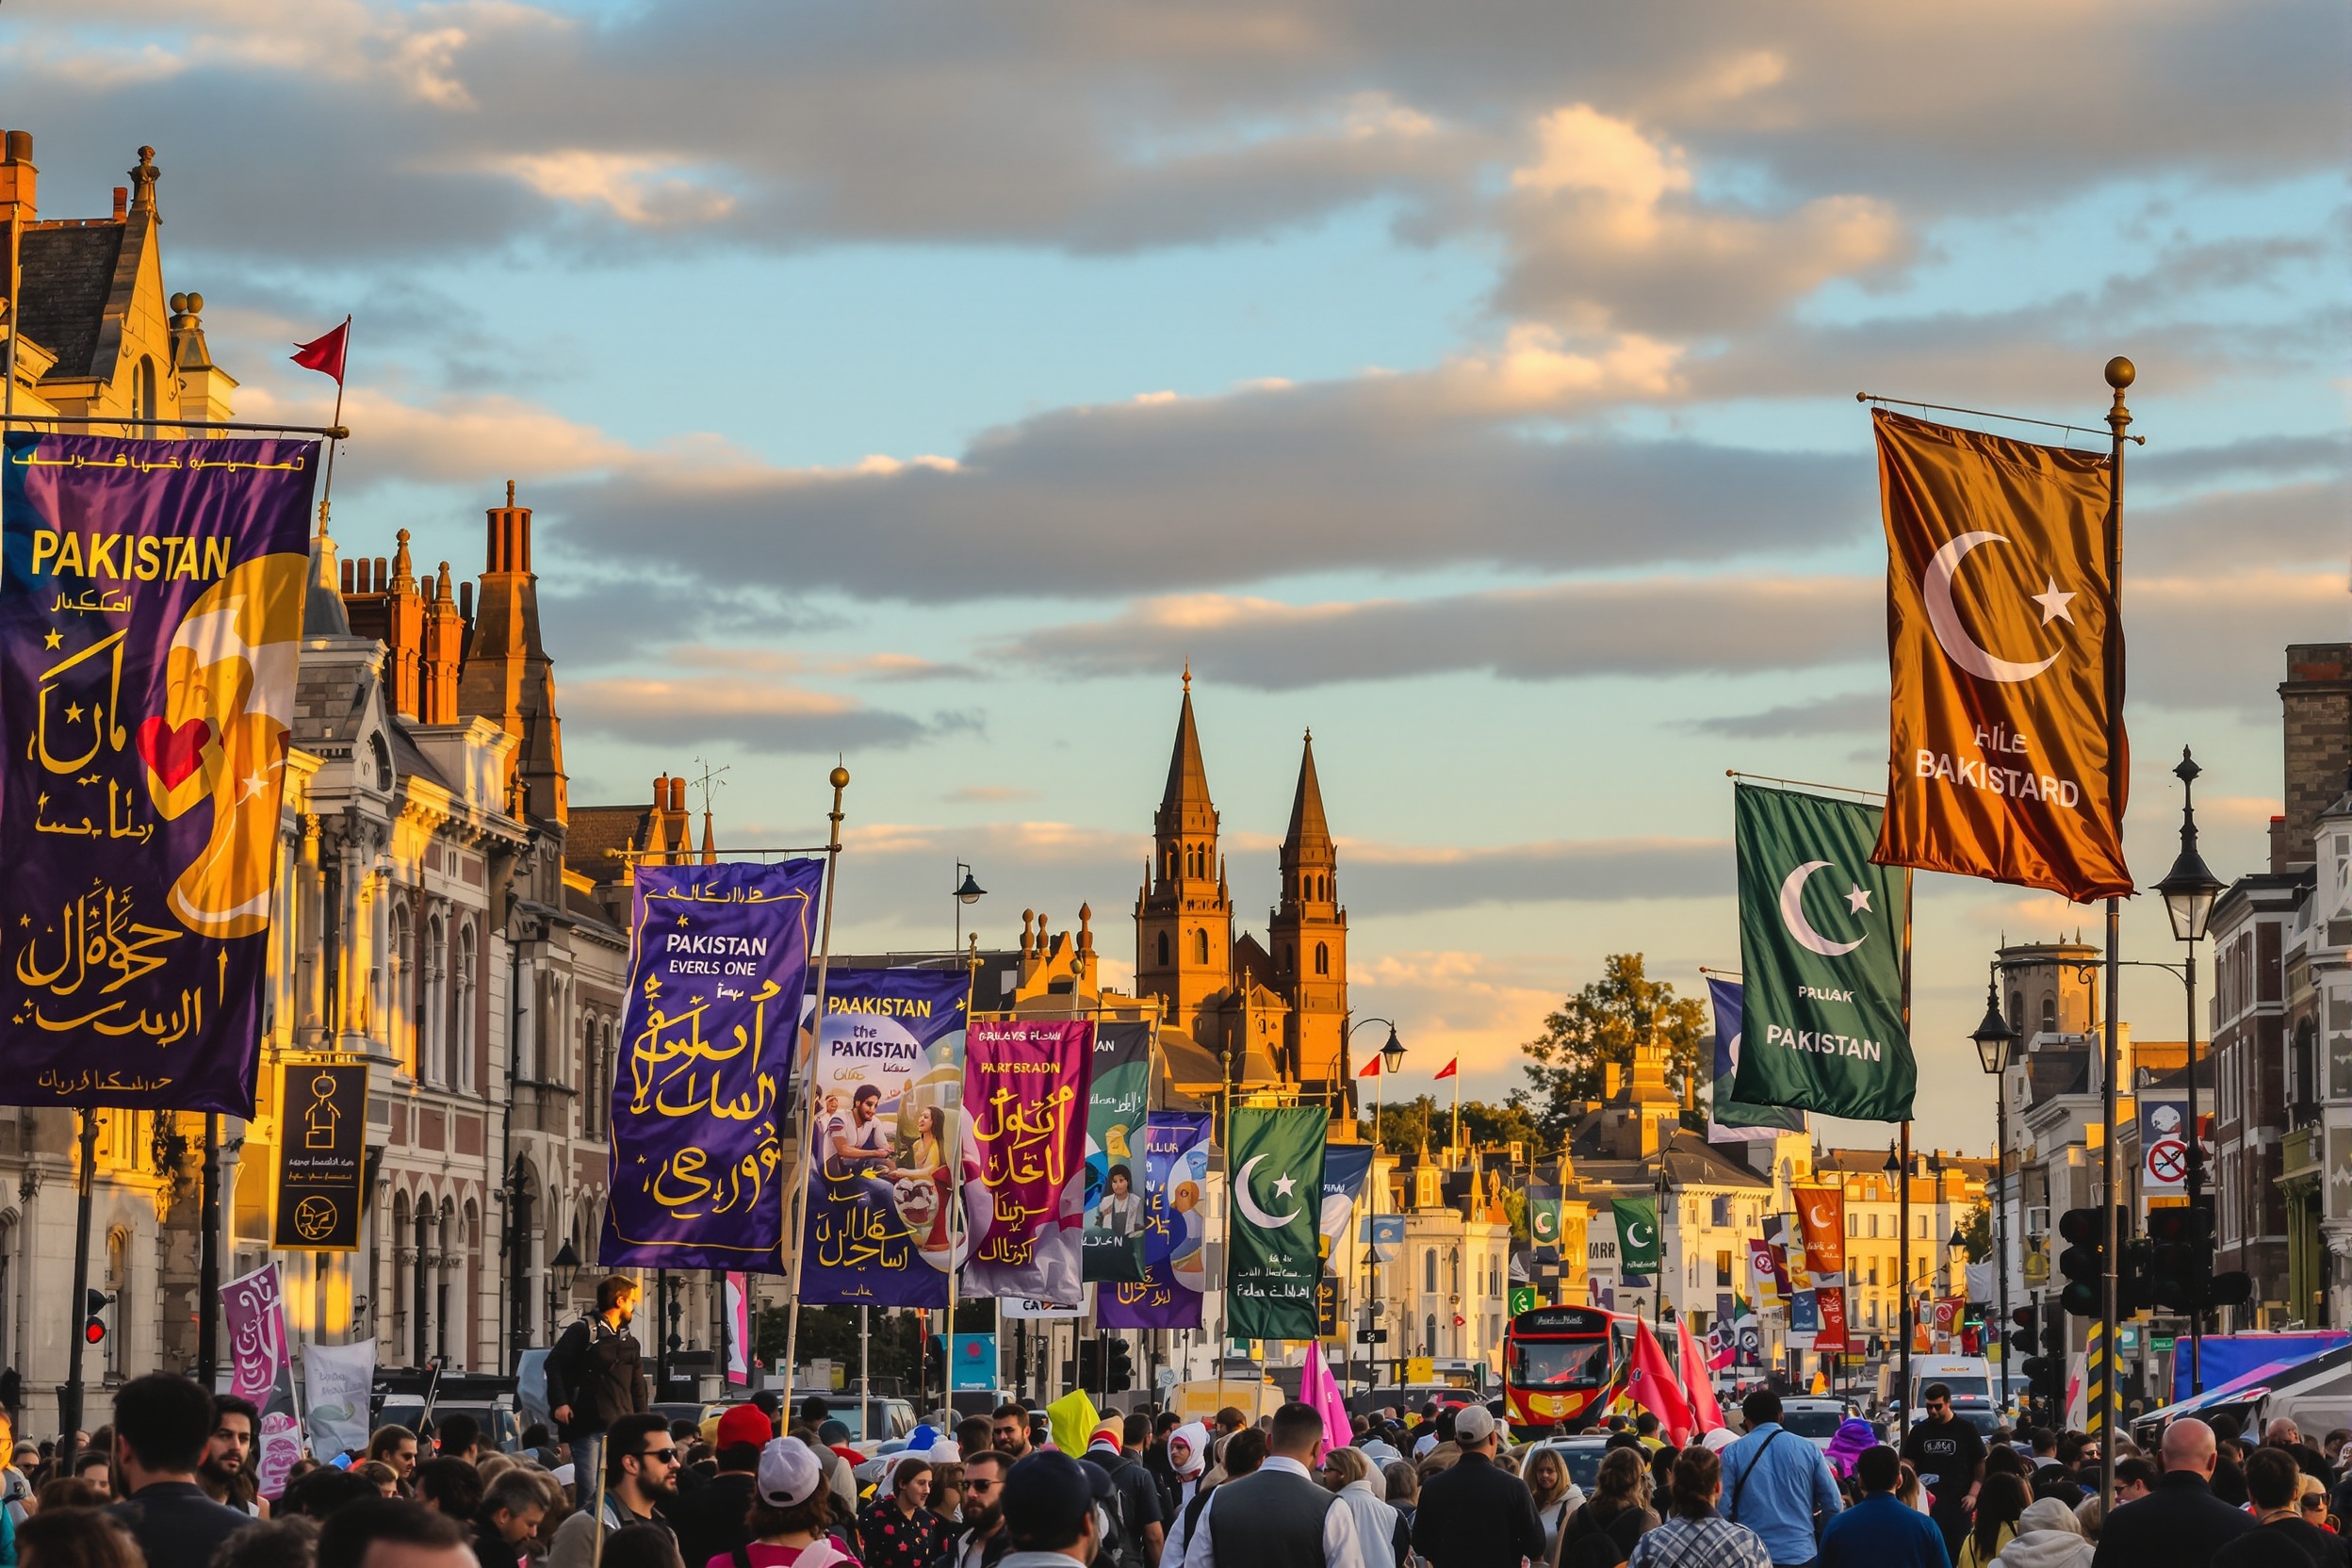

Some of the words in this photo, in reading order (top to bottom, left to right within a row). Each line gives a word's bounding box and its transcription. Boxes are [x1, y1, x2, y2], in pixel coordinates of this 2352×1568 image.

[31, 530, 231, 581] PAKISTAN
[1916, 749, 2080, 808] BAKISTARD
[666, 934, 767, 956] PAKISTAN
[725, 961, 757, 976] ONE
[828, 996, 931, 1018] PAAKISTAN
[831, 1040, 918, 1060] PAKISTAN
[1094, 1040, 1115, 1053] AN
[1767, 1024, 1881, 1062] PAKISTAN
